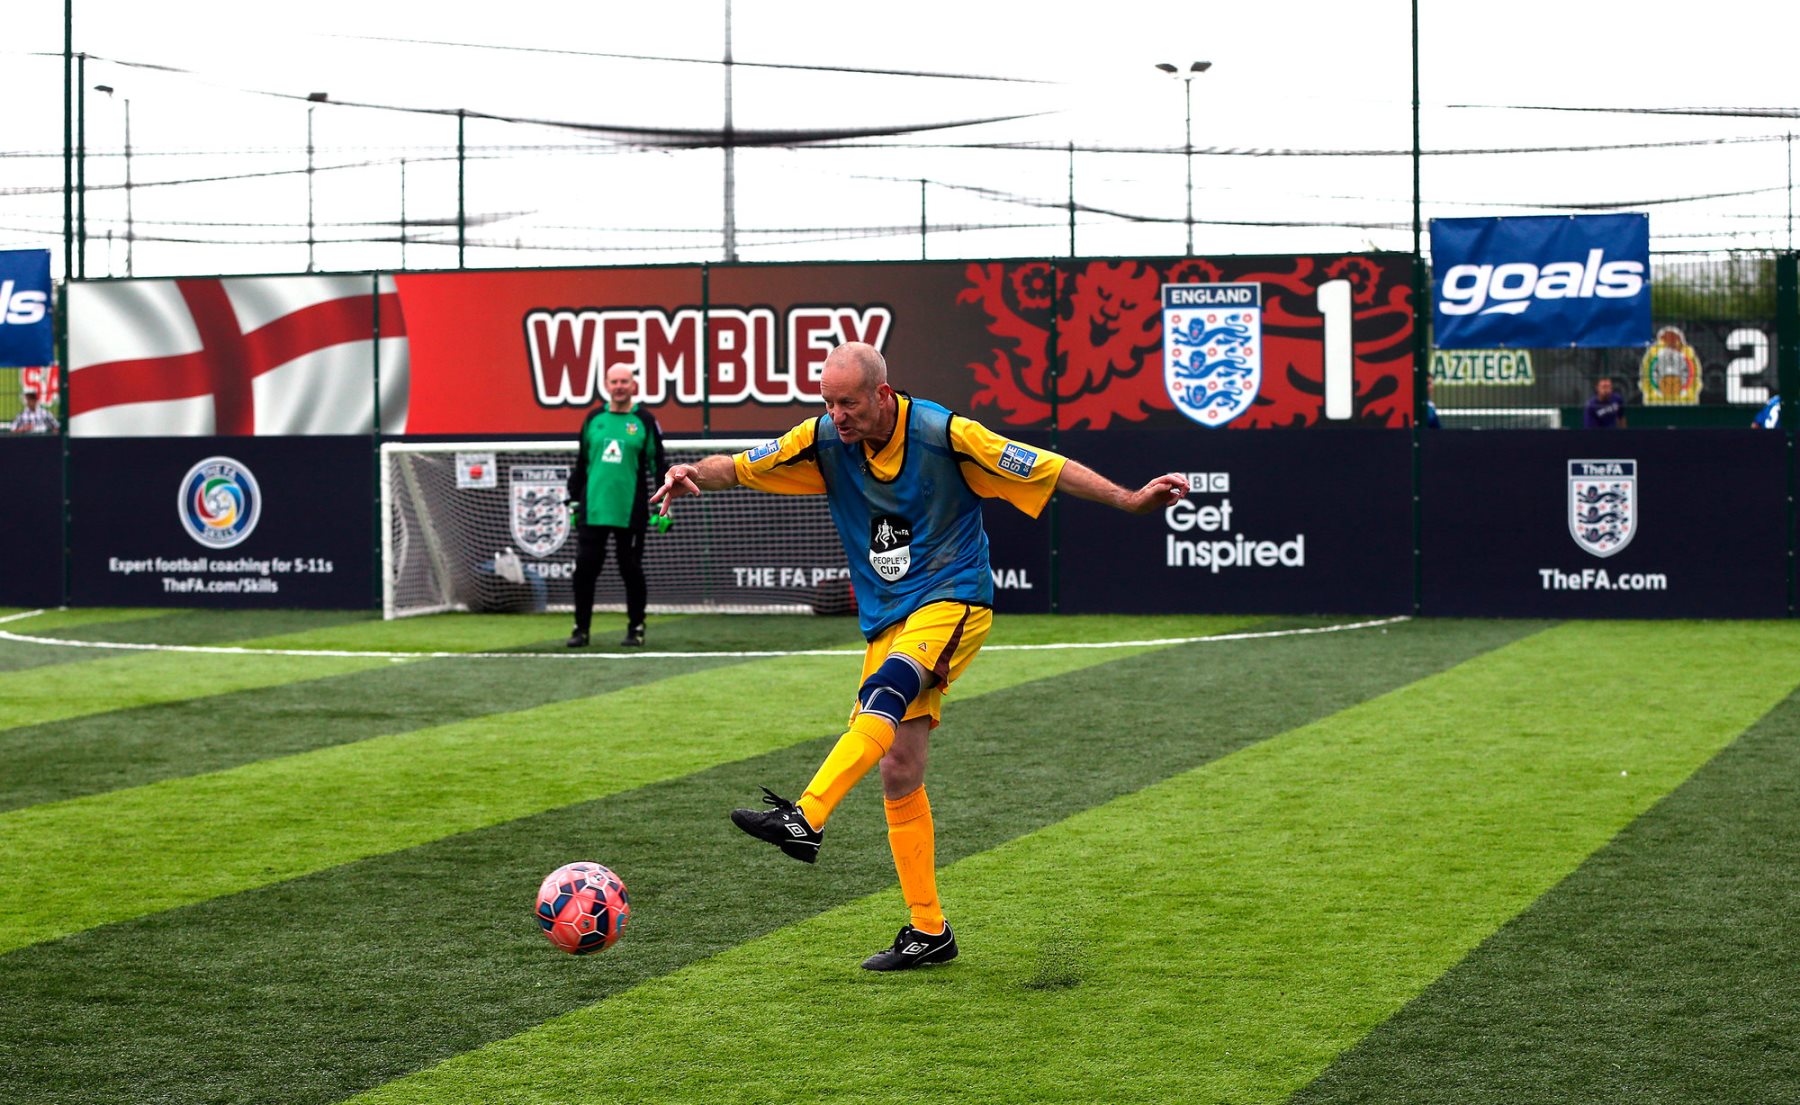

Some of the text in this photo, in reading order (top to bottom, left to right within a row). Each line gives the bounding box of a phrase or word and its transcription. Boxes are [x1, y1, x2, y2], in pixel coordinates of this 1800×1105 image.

[1439, 248, 1645, 315] goals
[1171, 289, 1252, 304] ENGLAND
[1317, 279, 1353, 419] 1
[1432, 352, 1532, 382] AZTECA
[1726, 329, 1769, 404] 2
[1001, 445, 1017, 468] BLUE
[1165, 498, 1232, 532] Get
[873, 556, 908, 565] PEOPLE'S
[1166, 533, 1304, 573] Inspired
[109, 557, 333, 576] Expert football coaching for 5-11s
[880, 565, 901, 575] CUP
[162, 577, 279, 593] TheFA.com/Skills
[733, 567, 776, 588] THE
[781, 567, 807, 588] FA
[991, 568, 1033, 589] NAL
[1539, 569, 1667, 591] TheFA.com
